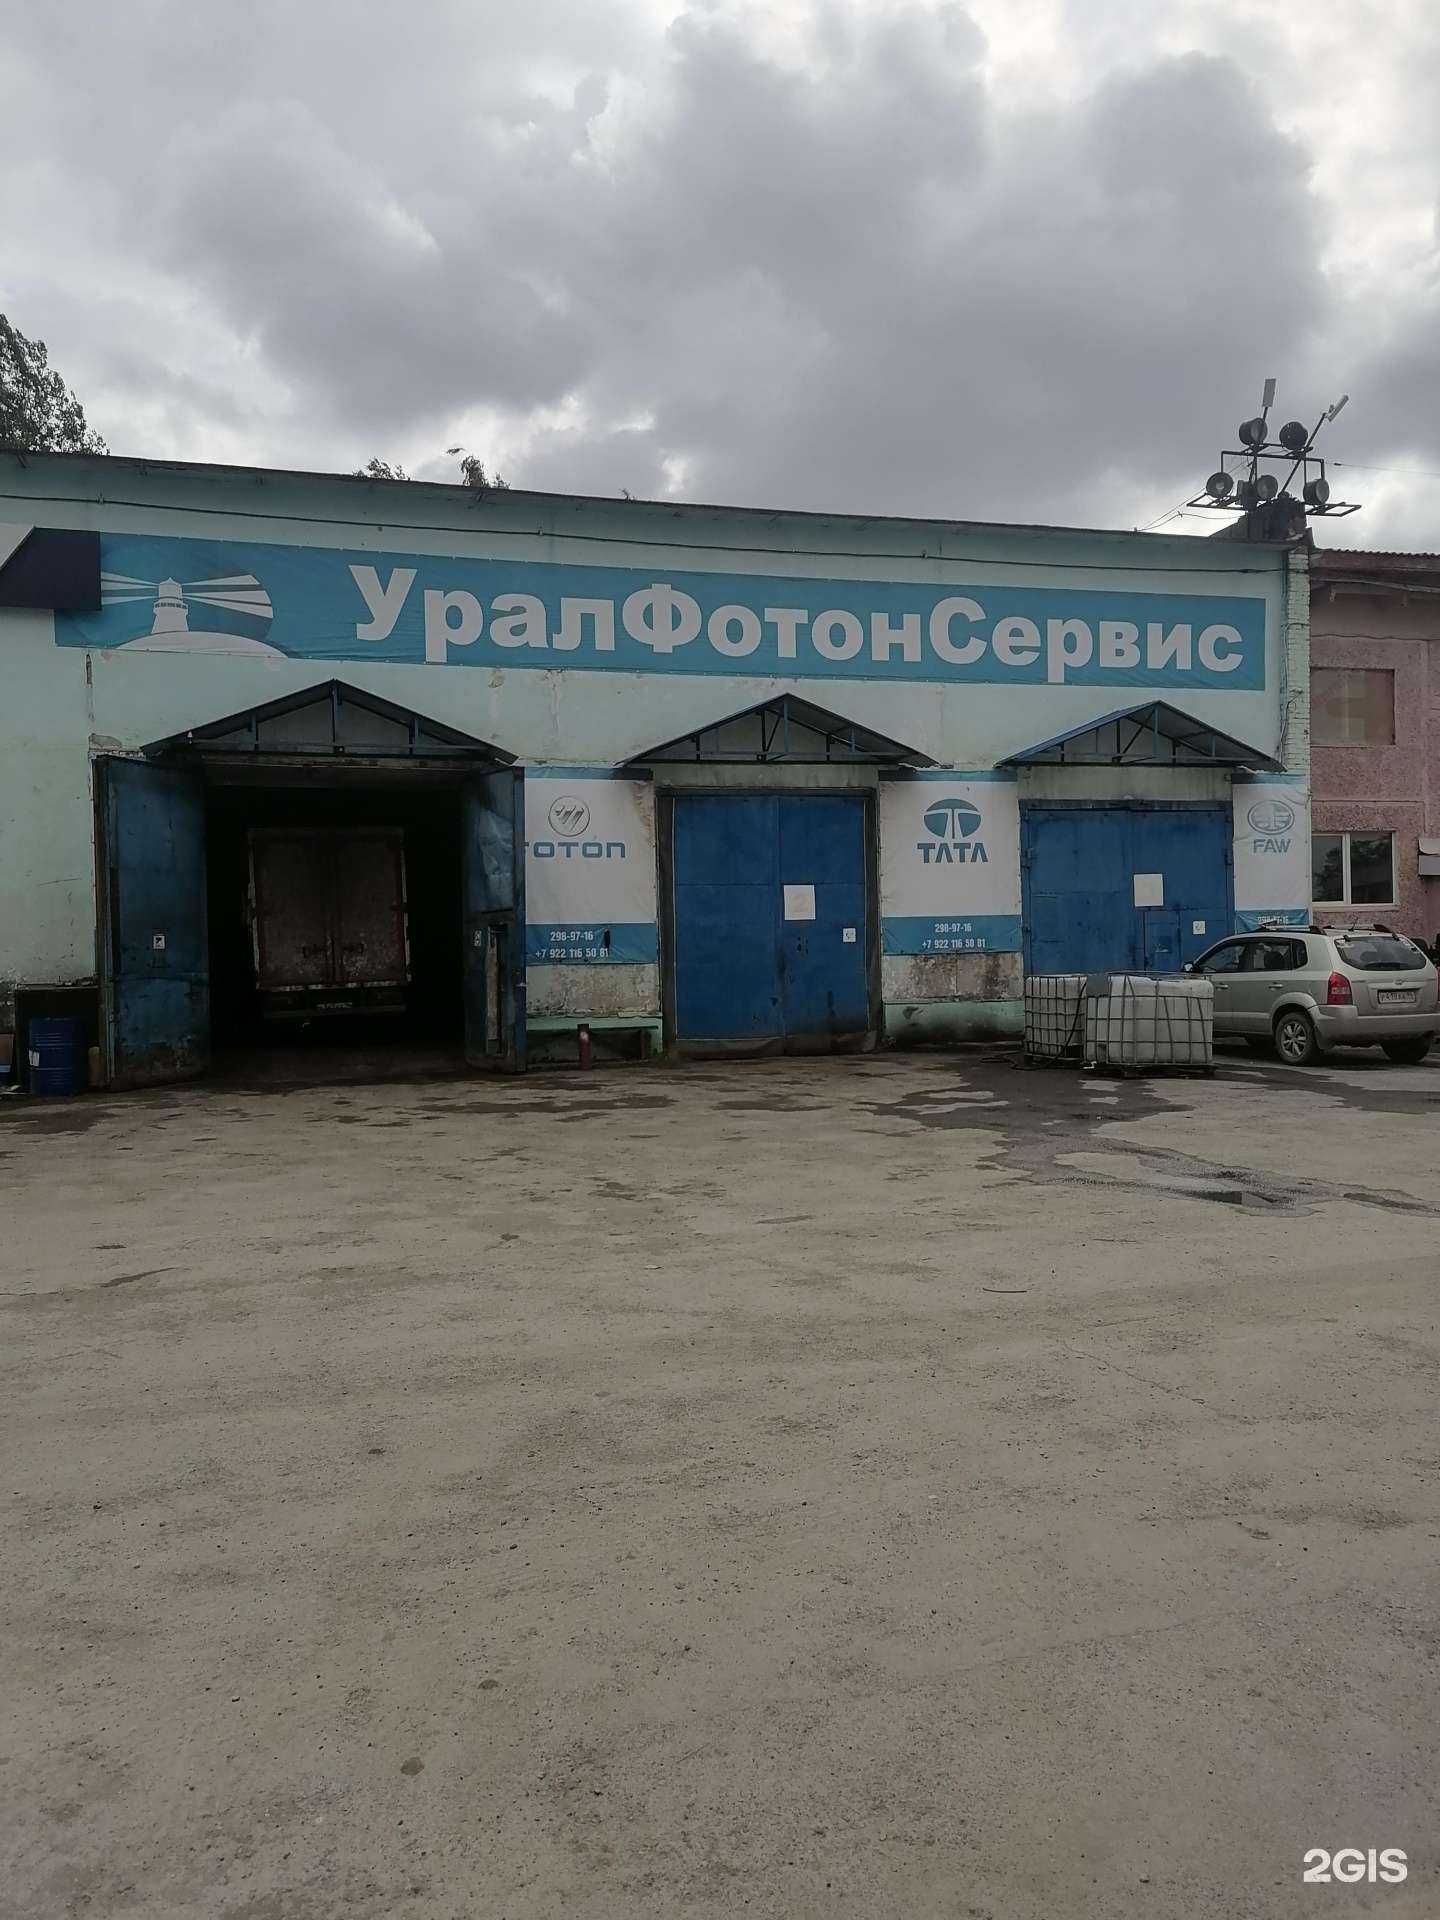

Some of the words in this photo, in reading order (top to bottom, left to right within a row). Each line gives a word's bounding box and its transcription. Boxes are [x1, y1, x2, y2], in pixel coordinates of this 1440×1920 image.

[348, 564, 1244, 683] УралФотонСервис
[1253, 838, 1291, 853] FAW
[917, 843, 988, 863] TATA
[550, 931, 593, 941] 298-97-16
[922, 940, 931, 949] +7
[934, 940, 949, 949] 922
[535, 949, 547, 958] +7
[549, 948, 566, 958] 922
